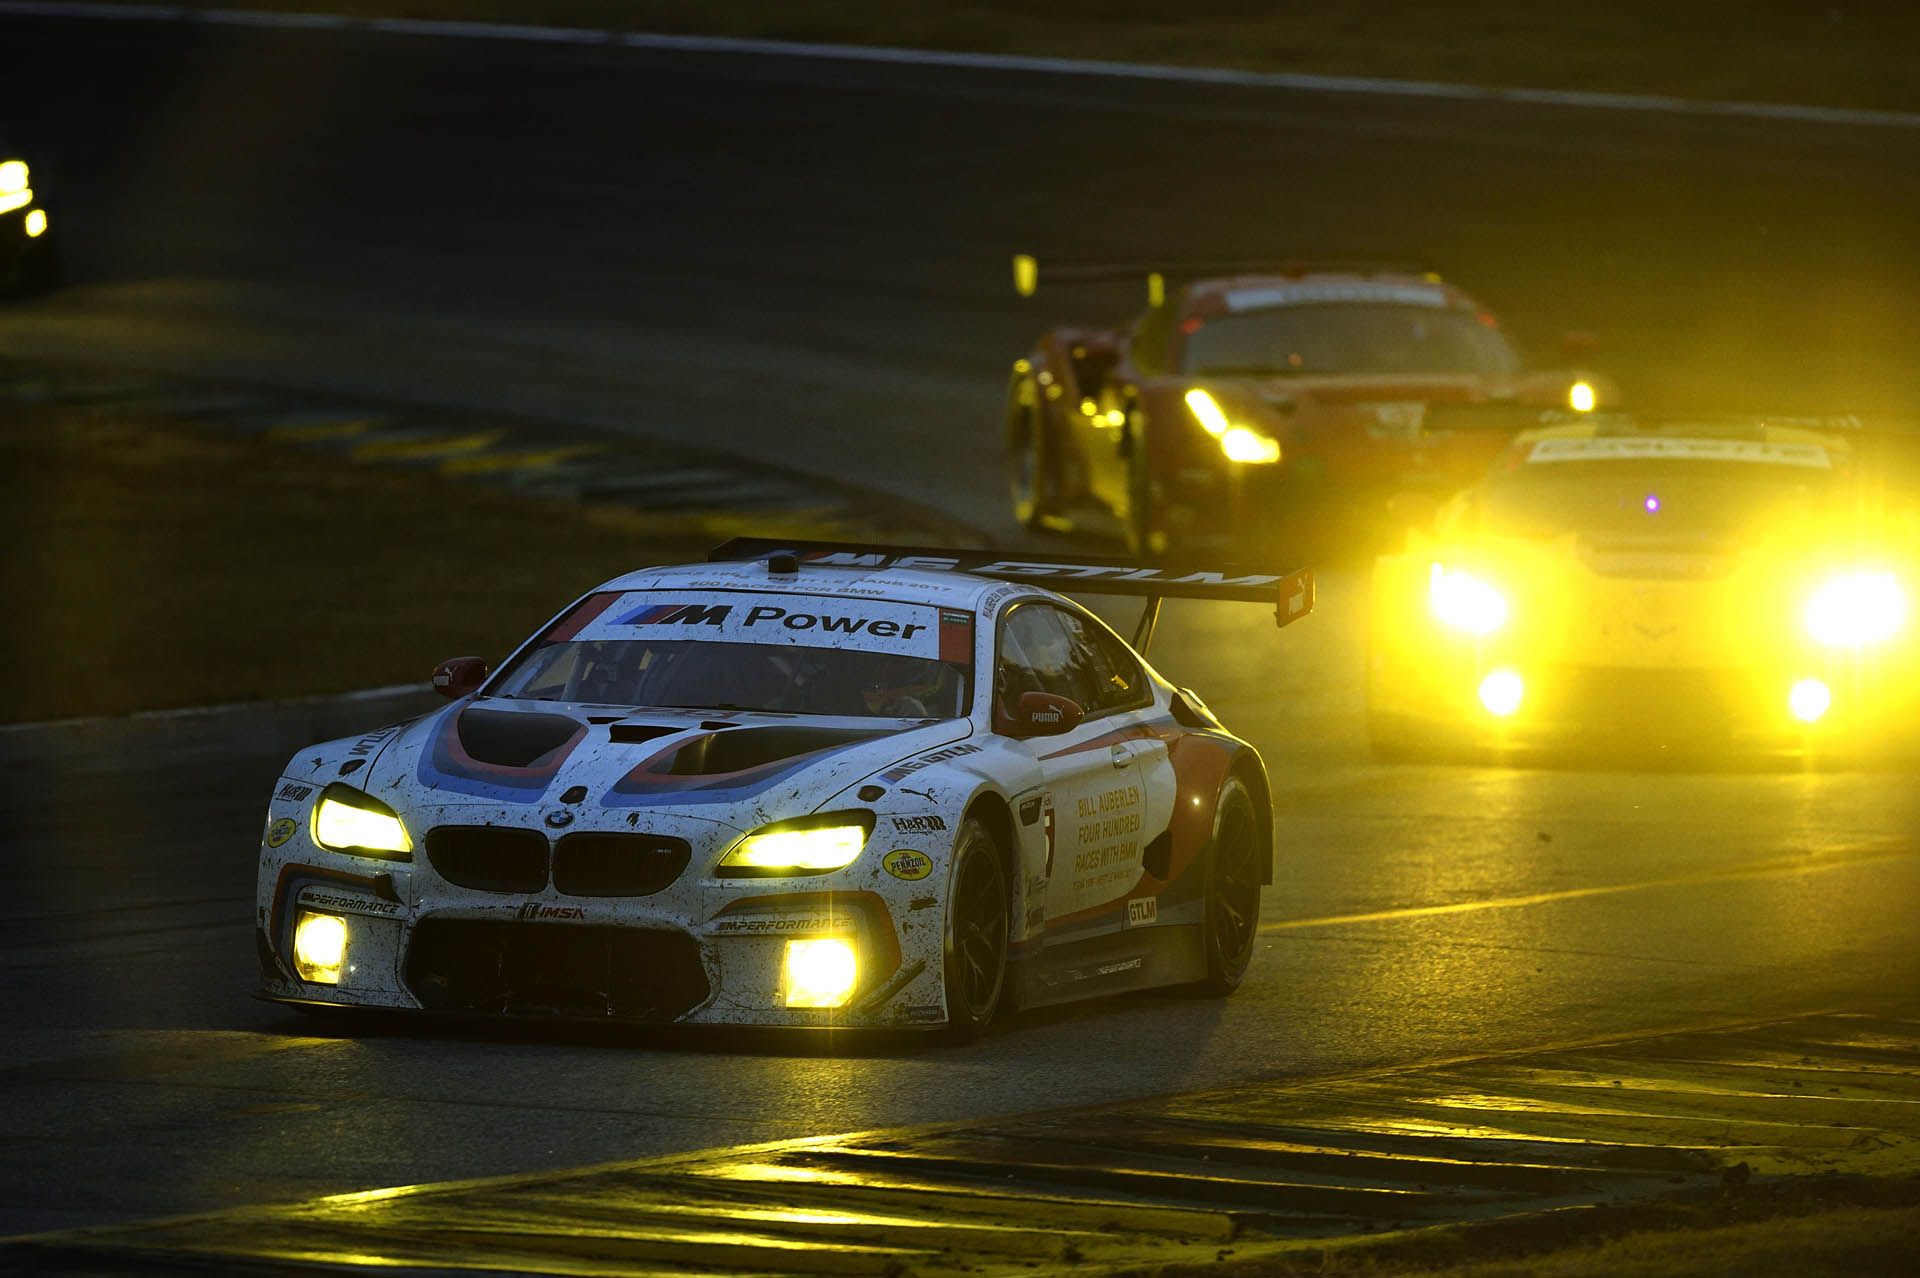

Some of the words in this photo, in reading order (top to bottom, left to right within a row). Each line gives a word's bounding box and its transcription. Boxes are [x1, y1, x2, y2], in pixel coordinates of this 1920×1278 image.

[969, 561, 1285, 587] GTLM
[792, 585, 831, 593] FOR
[835, 587, 888, 596] BMW
[742, 605, 928, 641] Power
[1031, 711, 1060, 723] PUMA
[918, 743, 984, 764] GTLM
[1078, 796, 1097, 818] BILL
[1099, 786, 1140, 813] AUBERLEN
[891, 816, 926, 830] H&R
[1078, 822, 1100, 845] FOUR
[1102, 814, 1140, 839] HUNDRED
[890, 857, 927, 872] PENNZOIL
[540, 905, 585, 920] IMSA
[1129, 900, 1156, 921] GTLM
